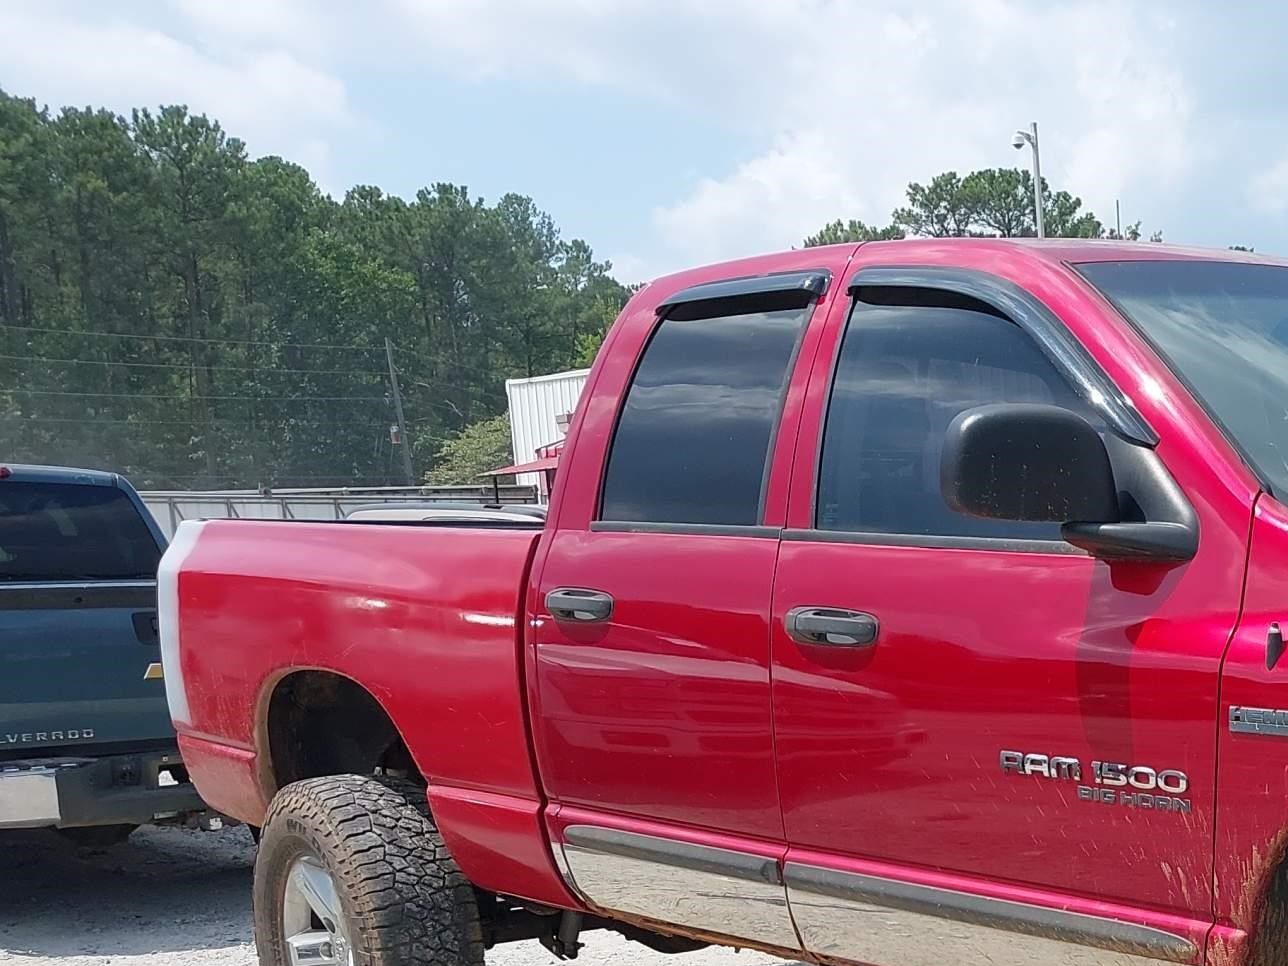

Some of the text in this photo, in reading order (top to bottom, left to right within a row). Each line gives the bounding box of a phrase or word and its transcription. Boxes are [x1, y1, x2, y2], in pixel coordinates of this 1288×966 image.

[1000, 750, 1188, 793] RAM 1500
[1077, 786, 1191, 812] BIG HORN
